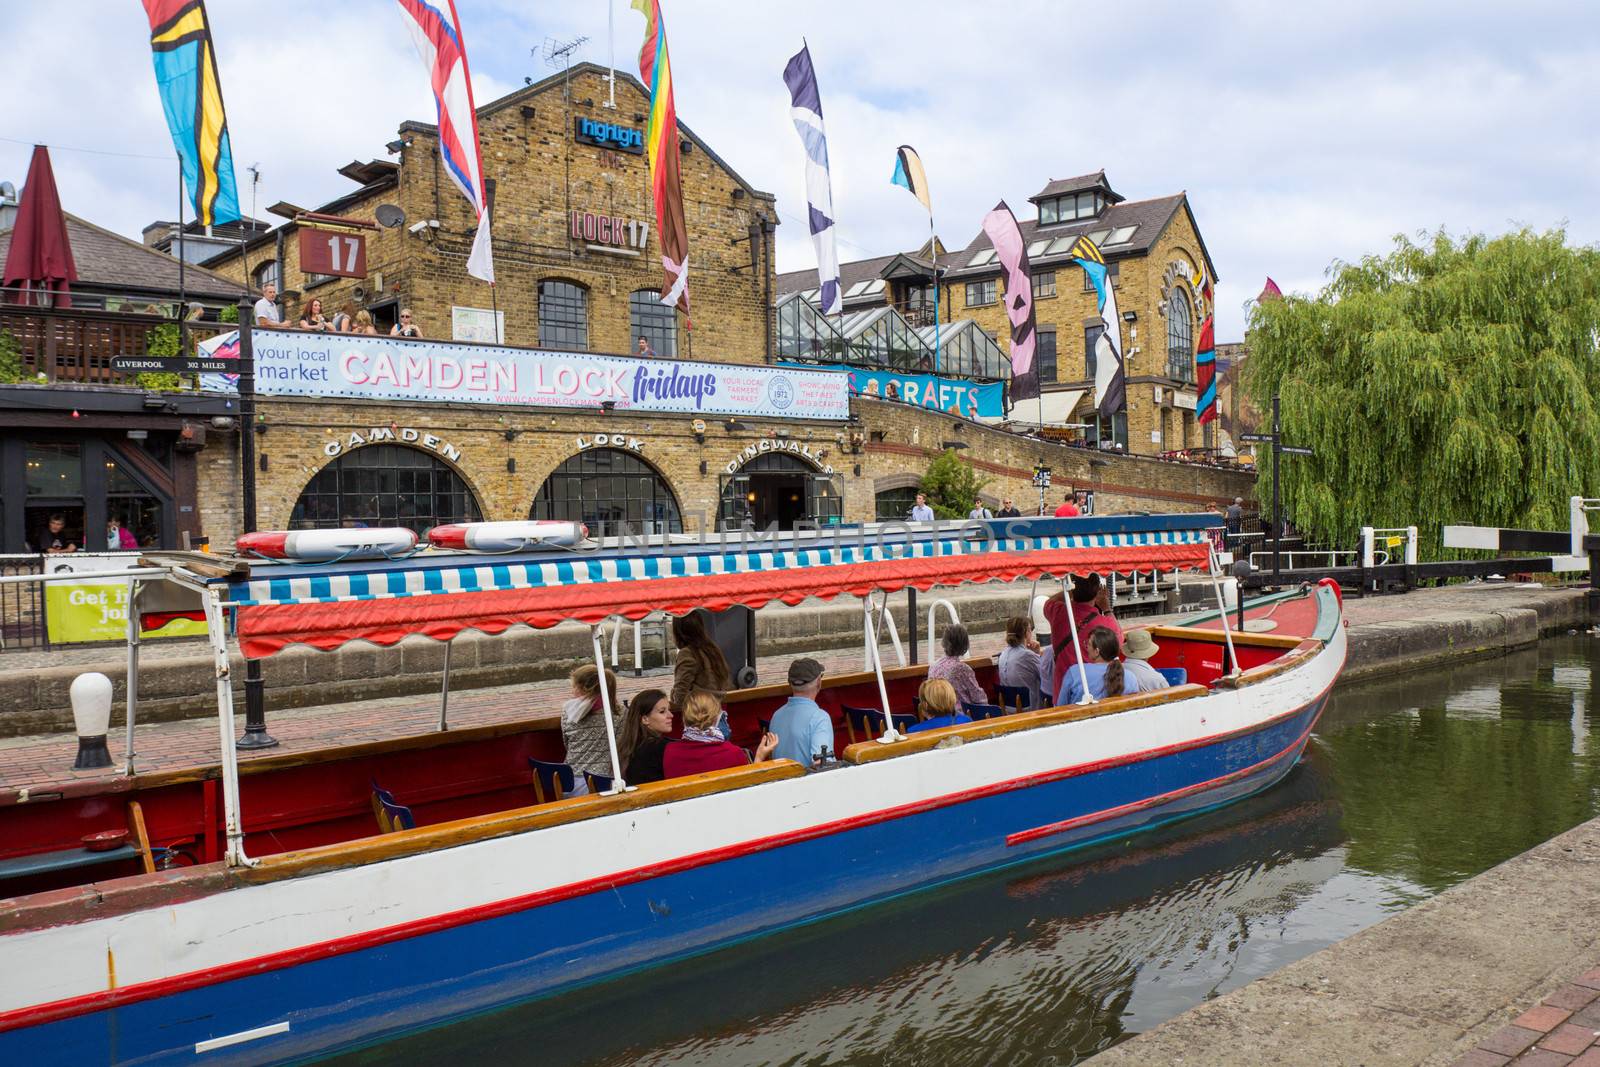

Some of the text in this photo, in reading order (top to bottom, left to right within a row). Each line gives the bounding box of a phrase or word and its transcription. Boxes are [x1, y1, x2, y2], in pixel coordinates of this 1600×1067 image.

[581, 118, 641, 147] highlight
[572, 211, 650, 249] LOCK 17
[328, 236, 359, 272] 17
[116, 361, 164, 369] LIVERPOOL
[257, 347, 330, 362] your local
[259, 363, 328, 381] market
[338, 350, 716, 410] CAMDEN LOCK fridays
[324, 428, 461, 462] CAMDEN
[576, 434, 645, 453] LOCK
[70, 589, 108, 605] Get
